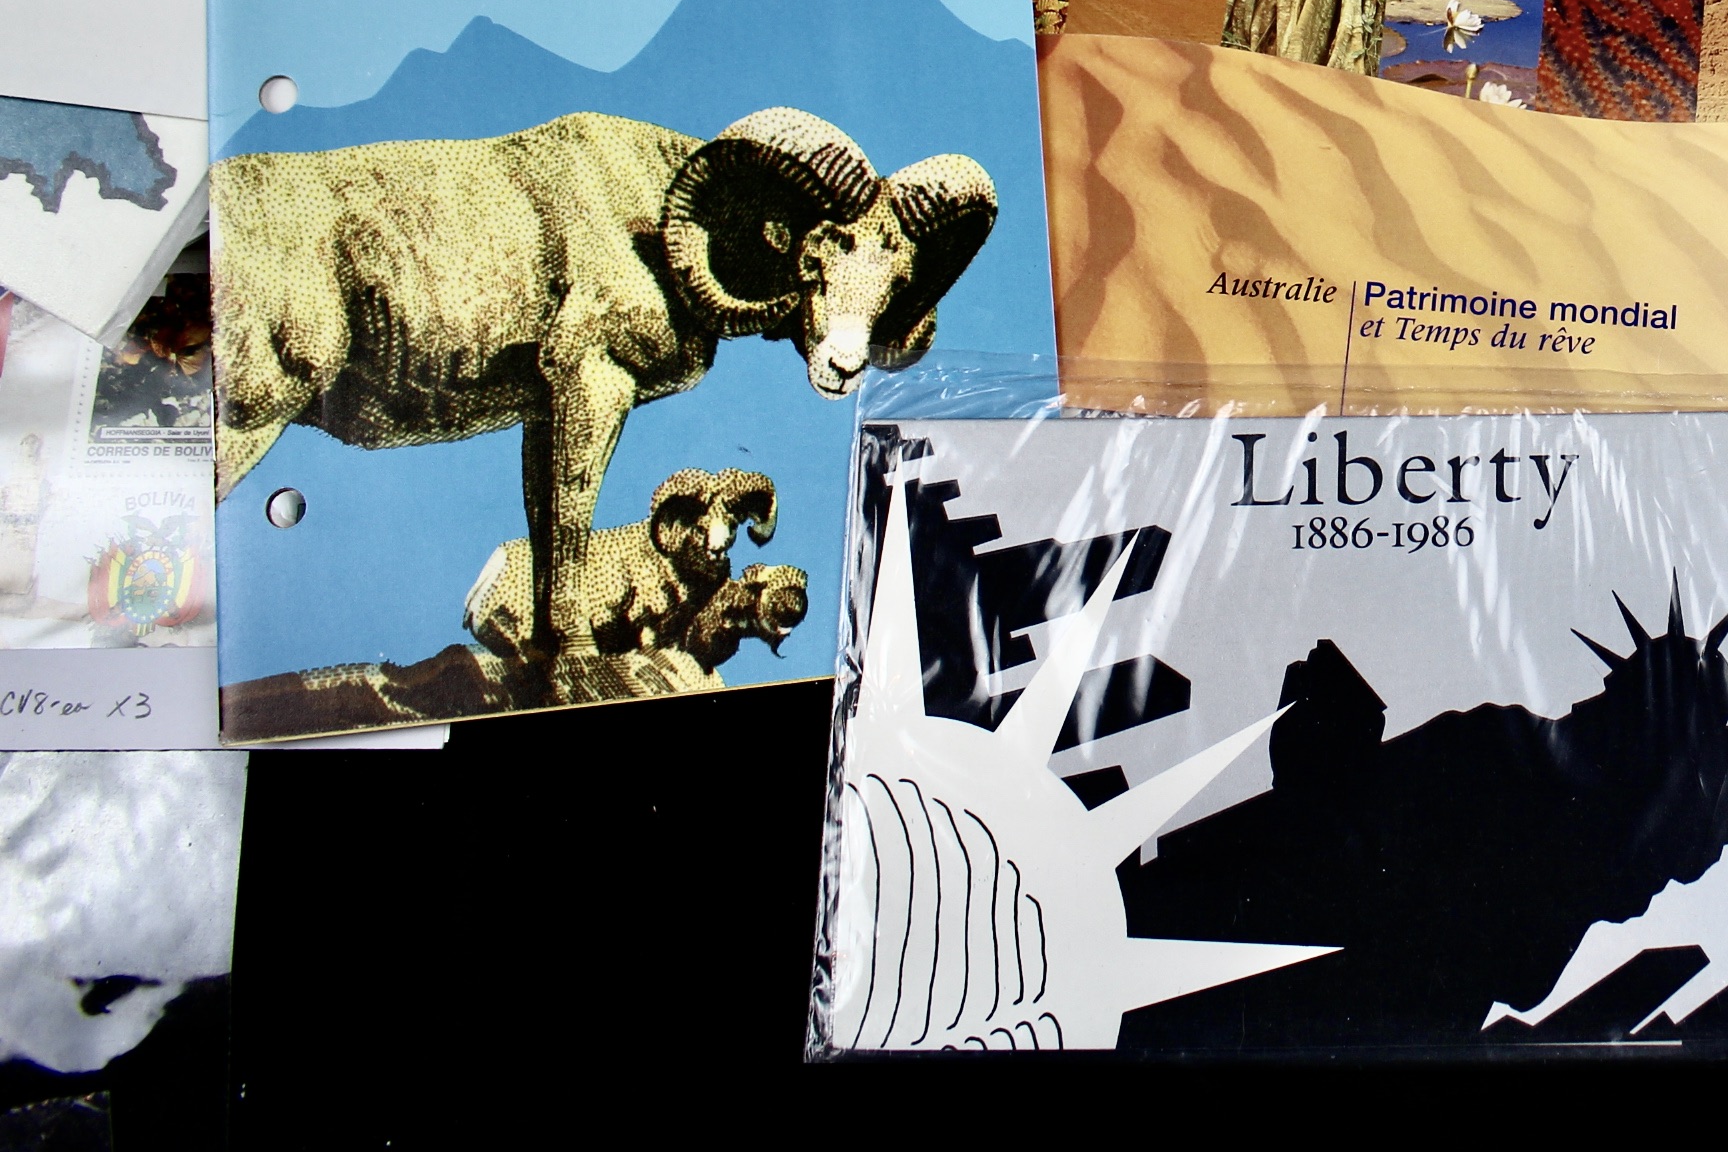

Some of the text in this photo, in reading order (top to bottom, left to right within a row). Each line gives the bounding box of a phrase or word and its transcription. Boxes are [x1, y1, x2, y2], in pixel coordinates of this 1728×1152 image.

[1206, 270, 1339, 305] Australie
[1363, 280, 1680, 330] Patrimoine mondial
[1359, 316, 1597, 356] et Temps du rêve
[87, 445, 214, 458] CORREOS DE BOLIV
[1230, 429, 1580, 531] Liberty
[124, 491, 197, 512] BOLIVIA
[1291, 514, 1477, 555] 1886-1986
